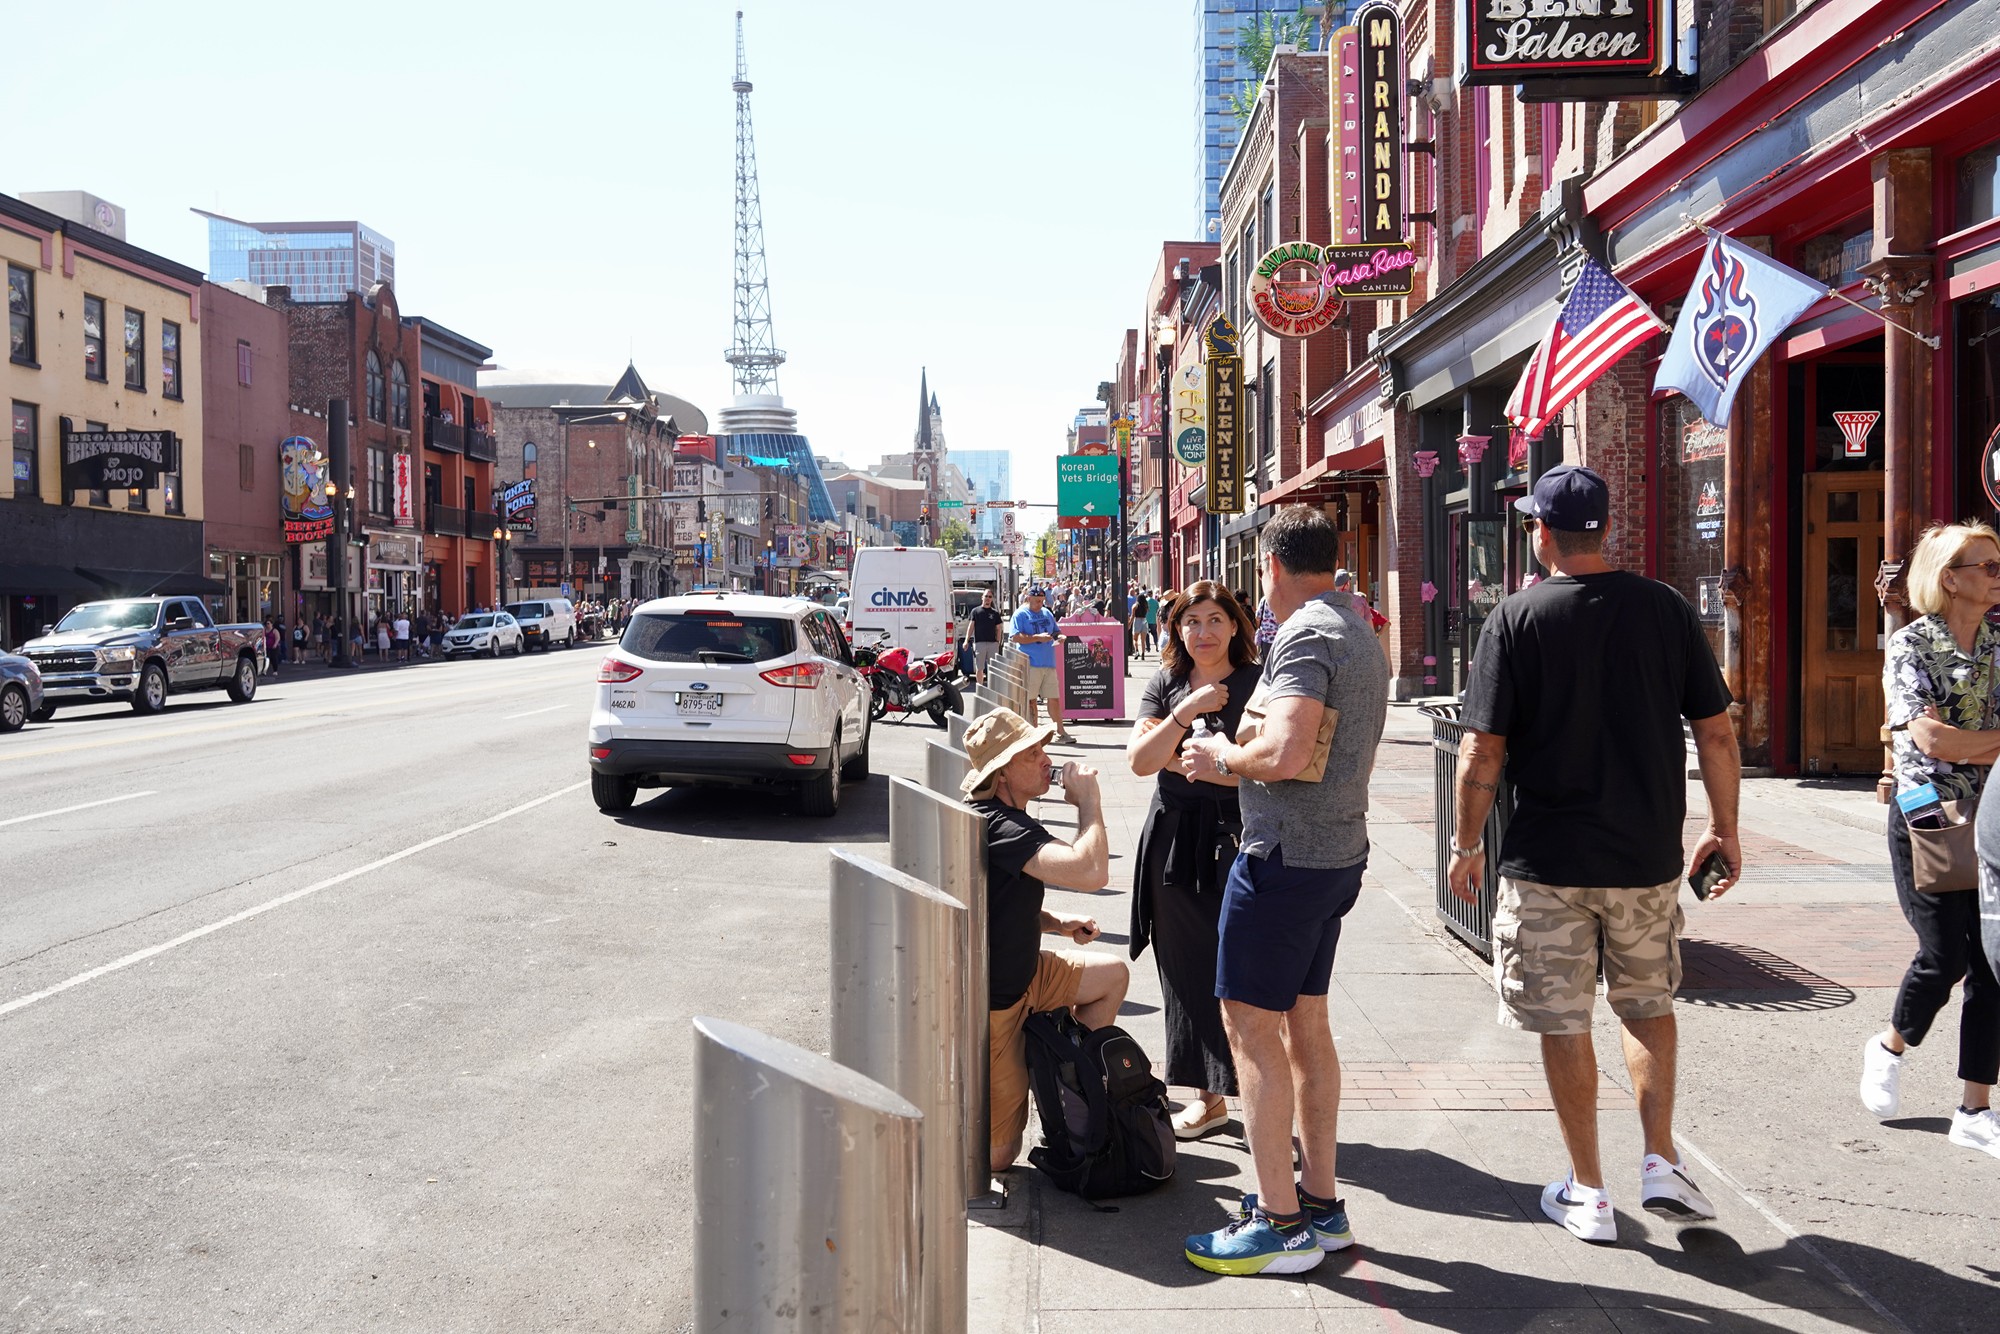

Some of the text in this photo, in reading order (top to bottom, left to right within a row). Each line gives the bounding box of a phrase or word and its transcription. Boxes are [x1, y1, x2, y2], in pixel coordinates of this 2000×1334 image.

[1485, 19, 1640, 61] Saloon
[1371, 19, 1391, 230] MIRANDA
[1343, 41, 1358, 235] LAMBERT'S
[1258, 244, 1320, 278] SAVANNA
[1322, 248, 1418, 288] Casa Rosa
[1255, 292, 1339, 334] CANDY KITCHE
[1218, 358, 1233, 366] the
[1838, 414, 1875, 422] YAZOO
[67, 433, 163, 441] BROADWAY
[1216, 367, 1234, 510] VALENTINE
[67, 441, 163, 464] BREWHOUSE
[103, 468, 143, 486] MOJO
[1061, 463, 1095, 472] Korean
[1062, 474, 1118, 484] Vets Bridge
[504, 480, 531, 501] ONKY
[285, 518, 333, 530] BETTY
[627, 701, 636, 709] AD
[683, 700, 717, 710] 8795-GC
[1283, 1230, 1311, 1251] HOKA
